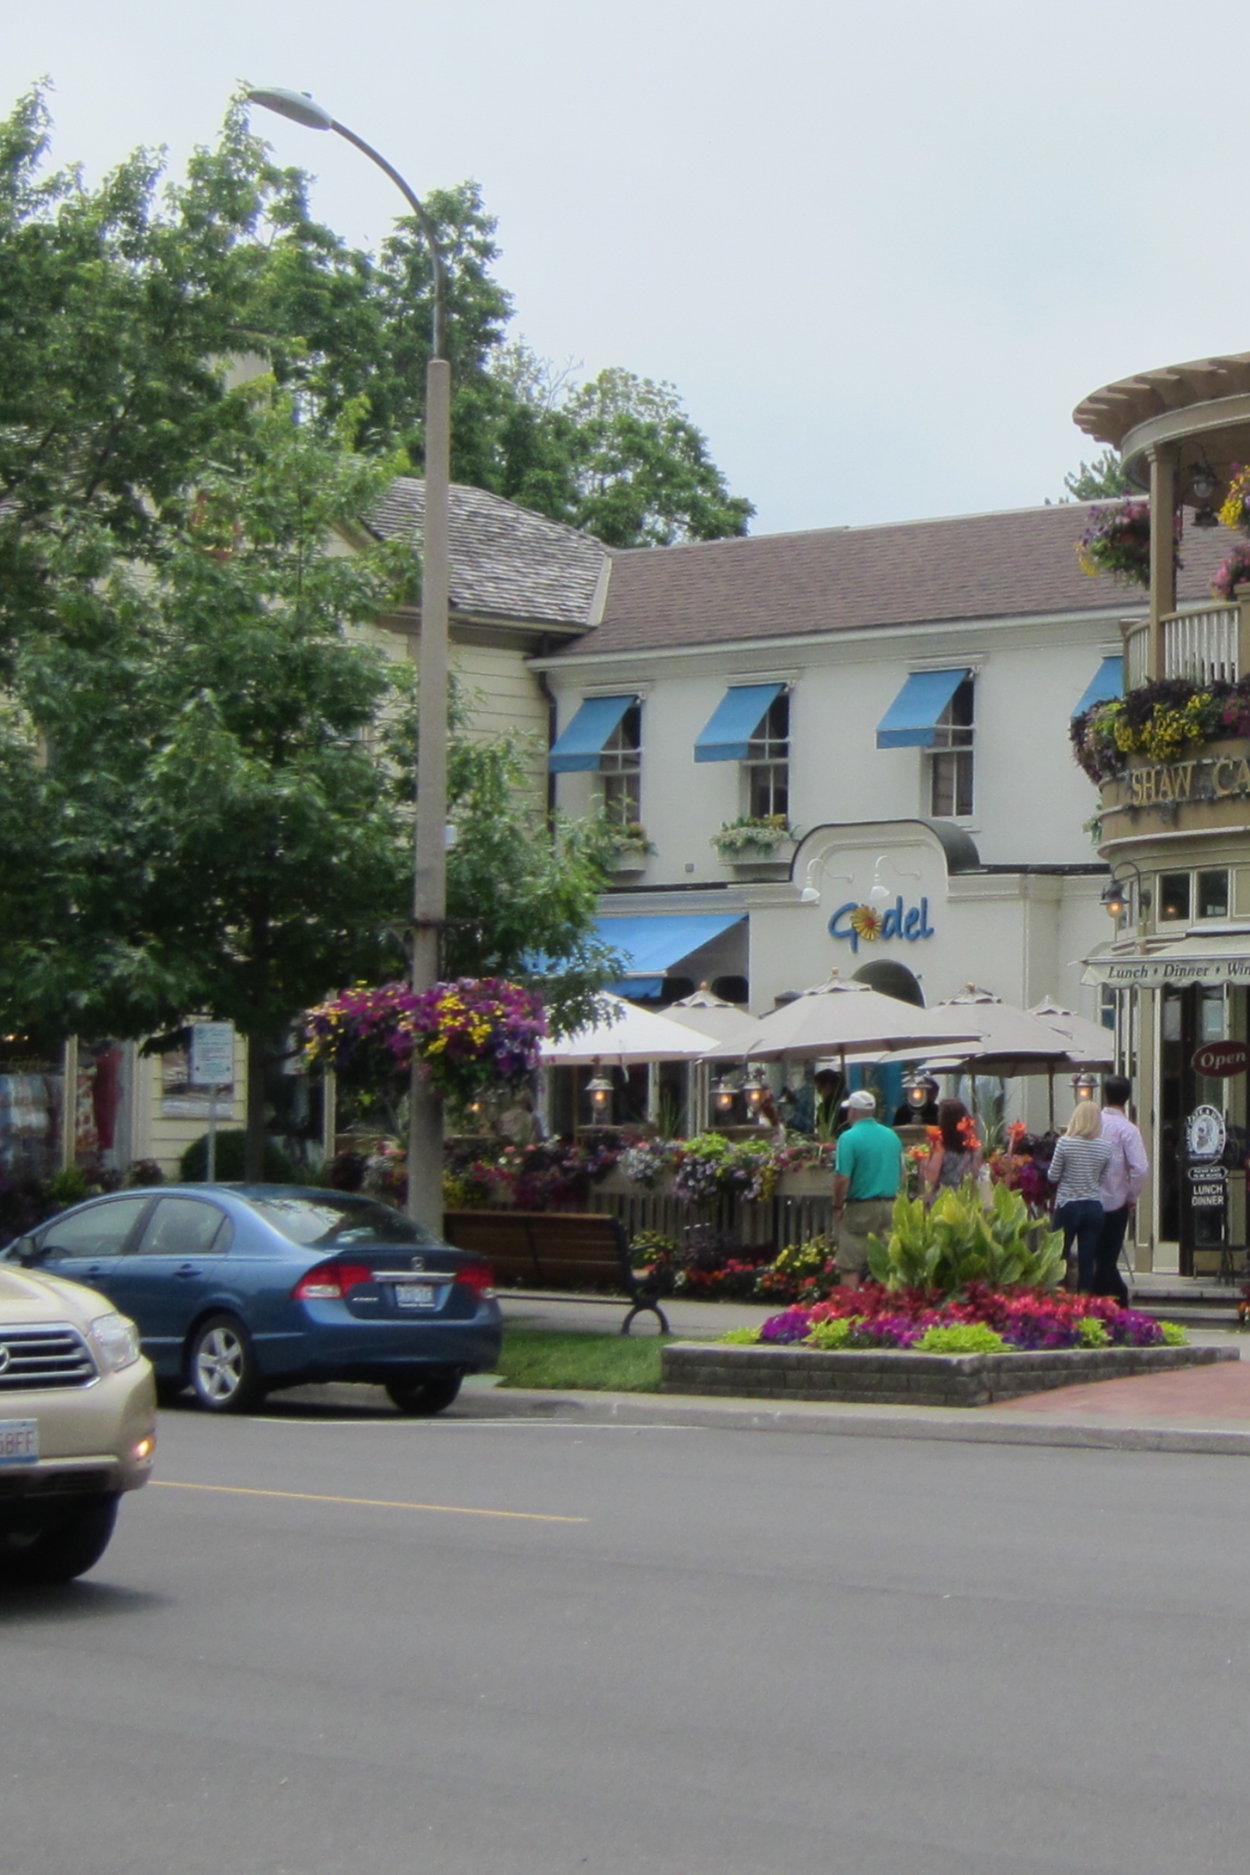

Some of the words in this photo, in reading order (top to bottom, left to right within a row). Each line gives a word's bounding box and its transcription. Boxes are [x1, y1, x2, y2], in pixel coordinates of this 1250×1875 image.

[1131, 763, 1193, 806] SHAW
[1108, 965, 1148, 979] Lunch
[1163, 963, 1209, 977] Dinner
[1200, 1052, 1246, 1070] Open
[1193, 1184, 1223, 1195] LUNCH
